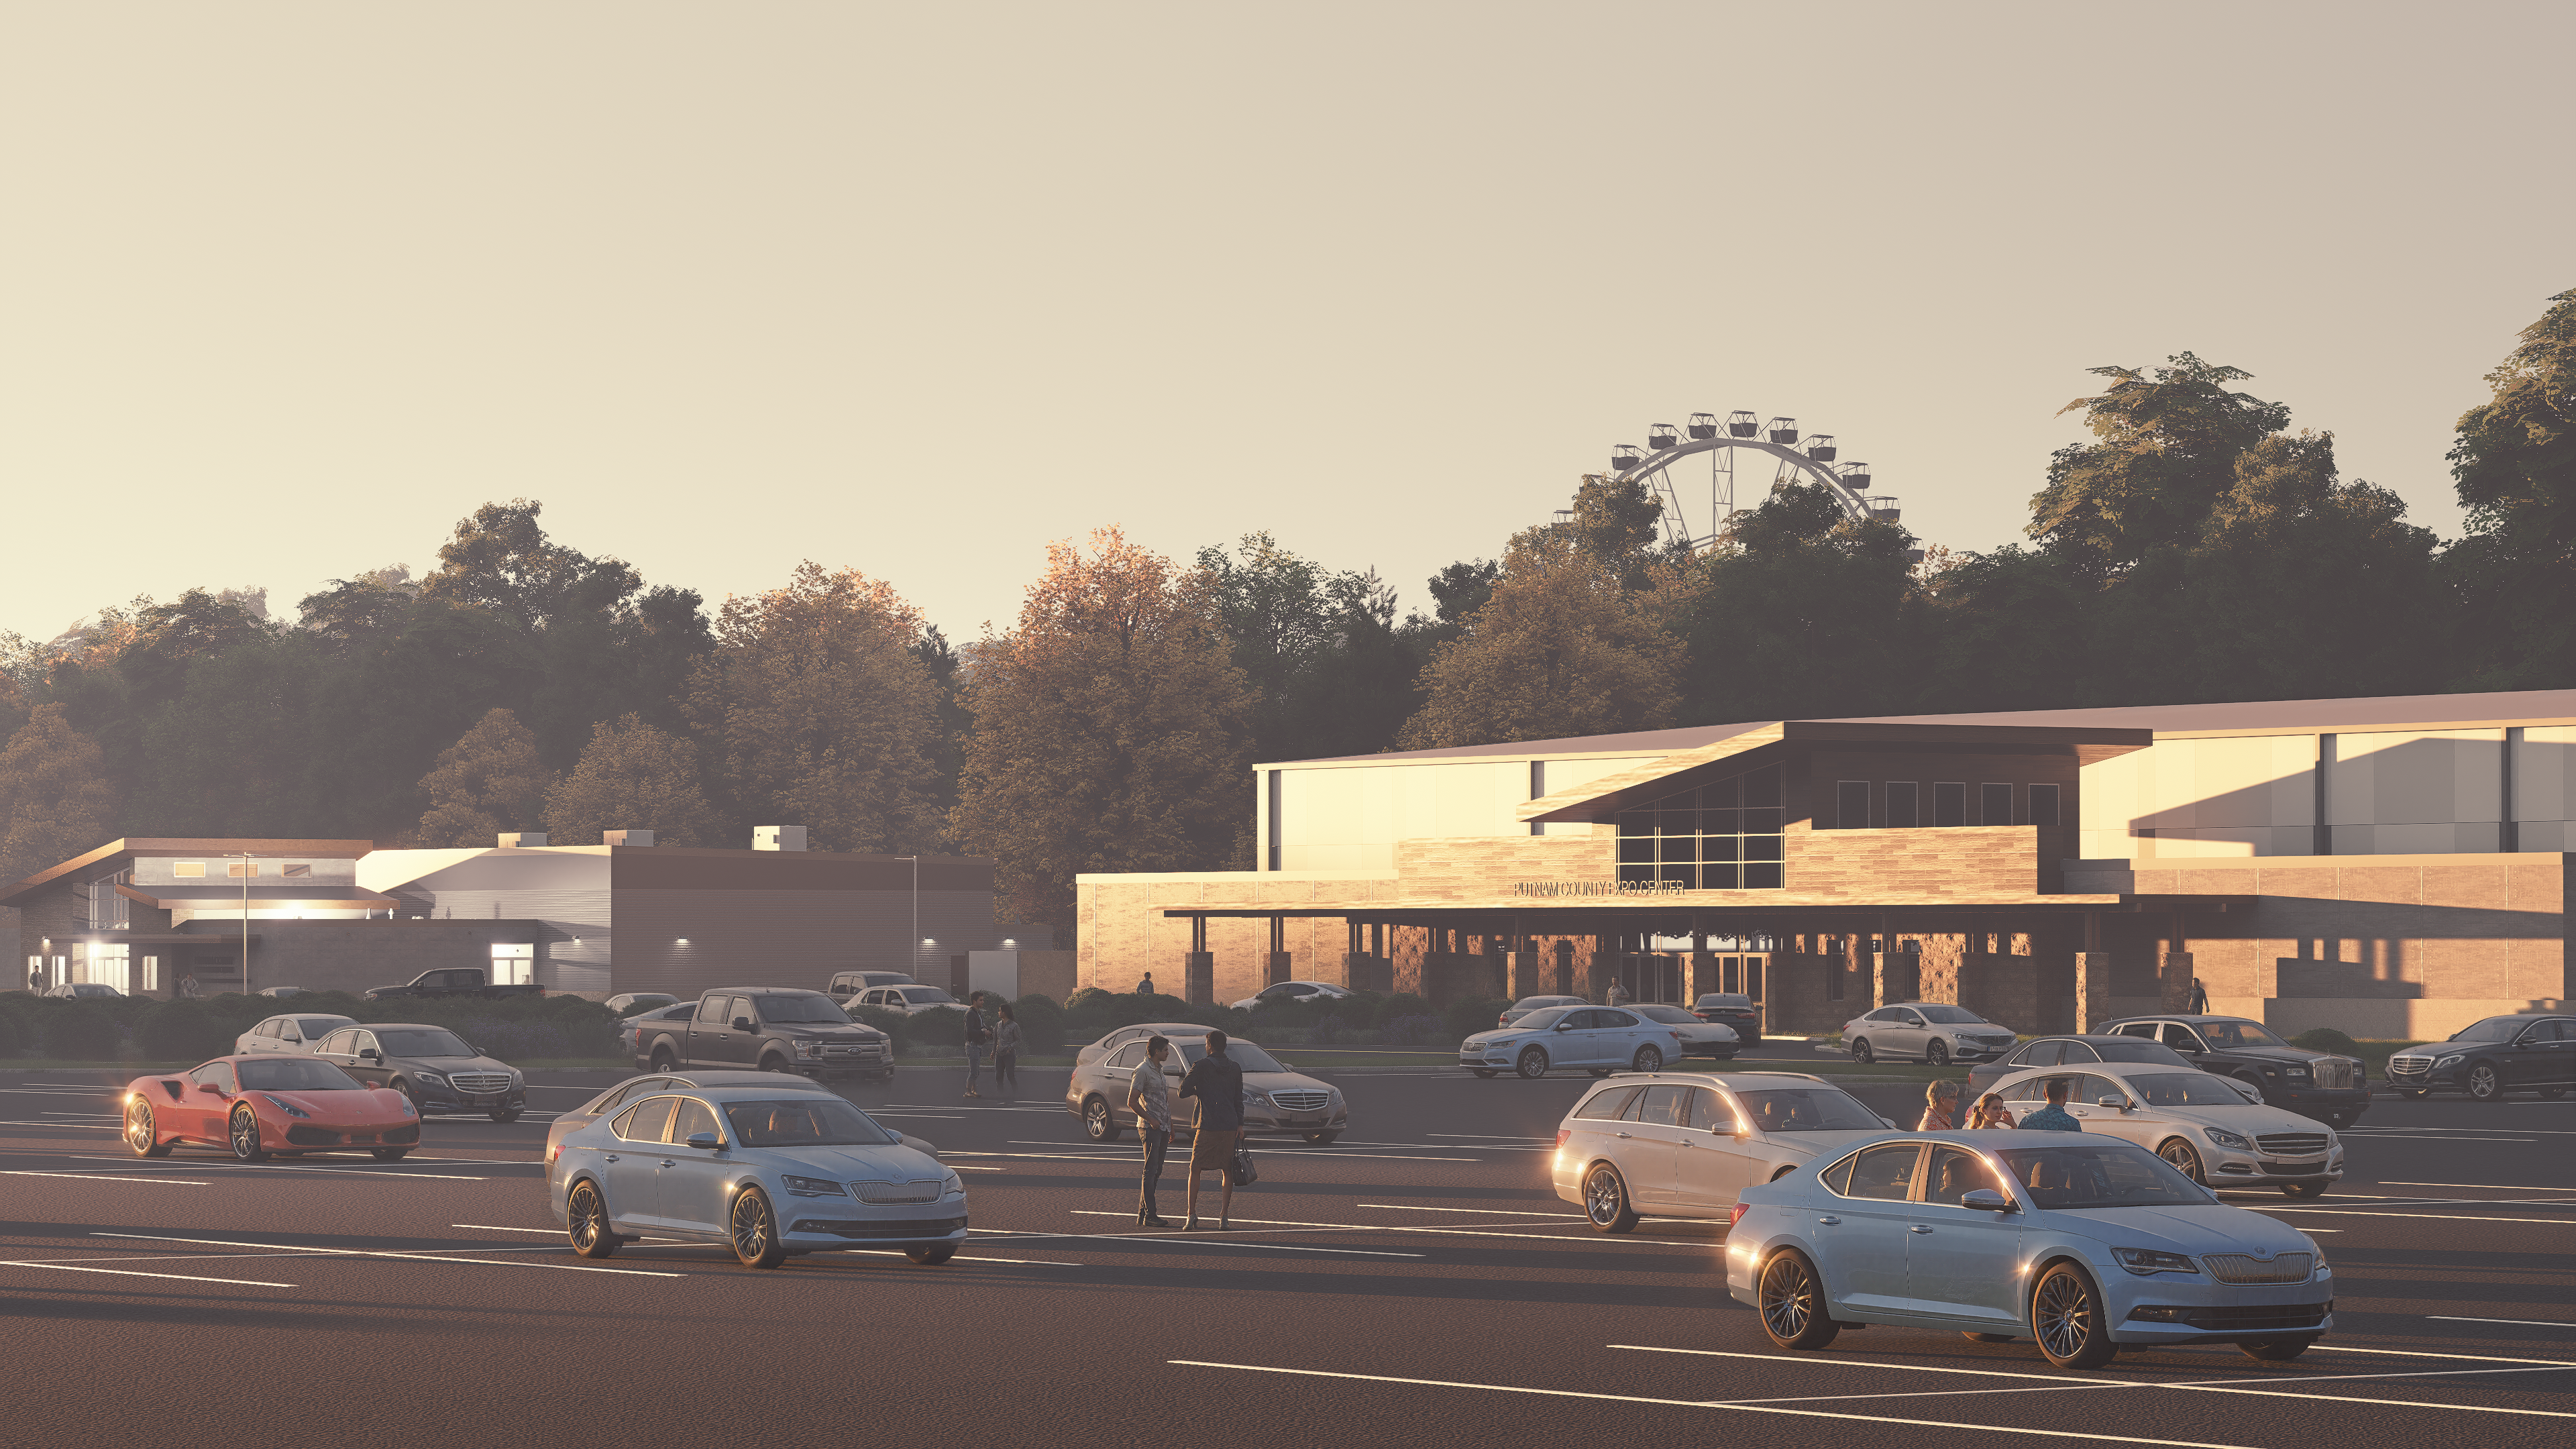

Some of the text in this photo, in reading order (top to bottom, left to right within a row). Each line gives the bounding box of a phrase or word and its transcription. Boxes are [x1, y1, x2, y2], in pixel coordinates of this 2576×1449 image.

[1513, 880, 1685, 896] PUTNAM COUNTY EXPO CENTER
